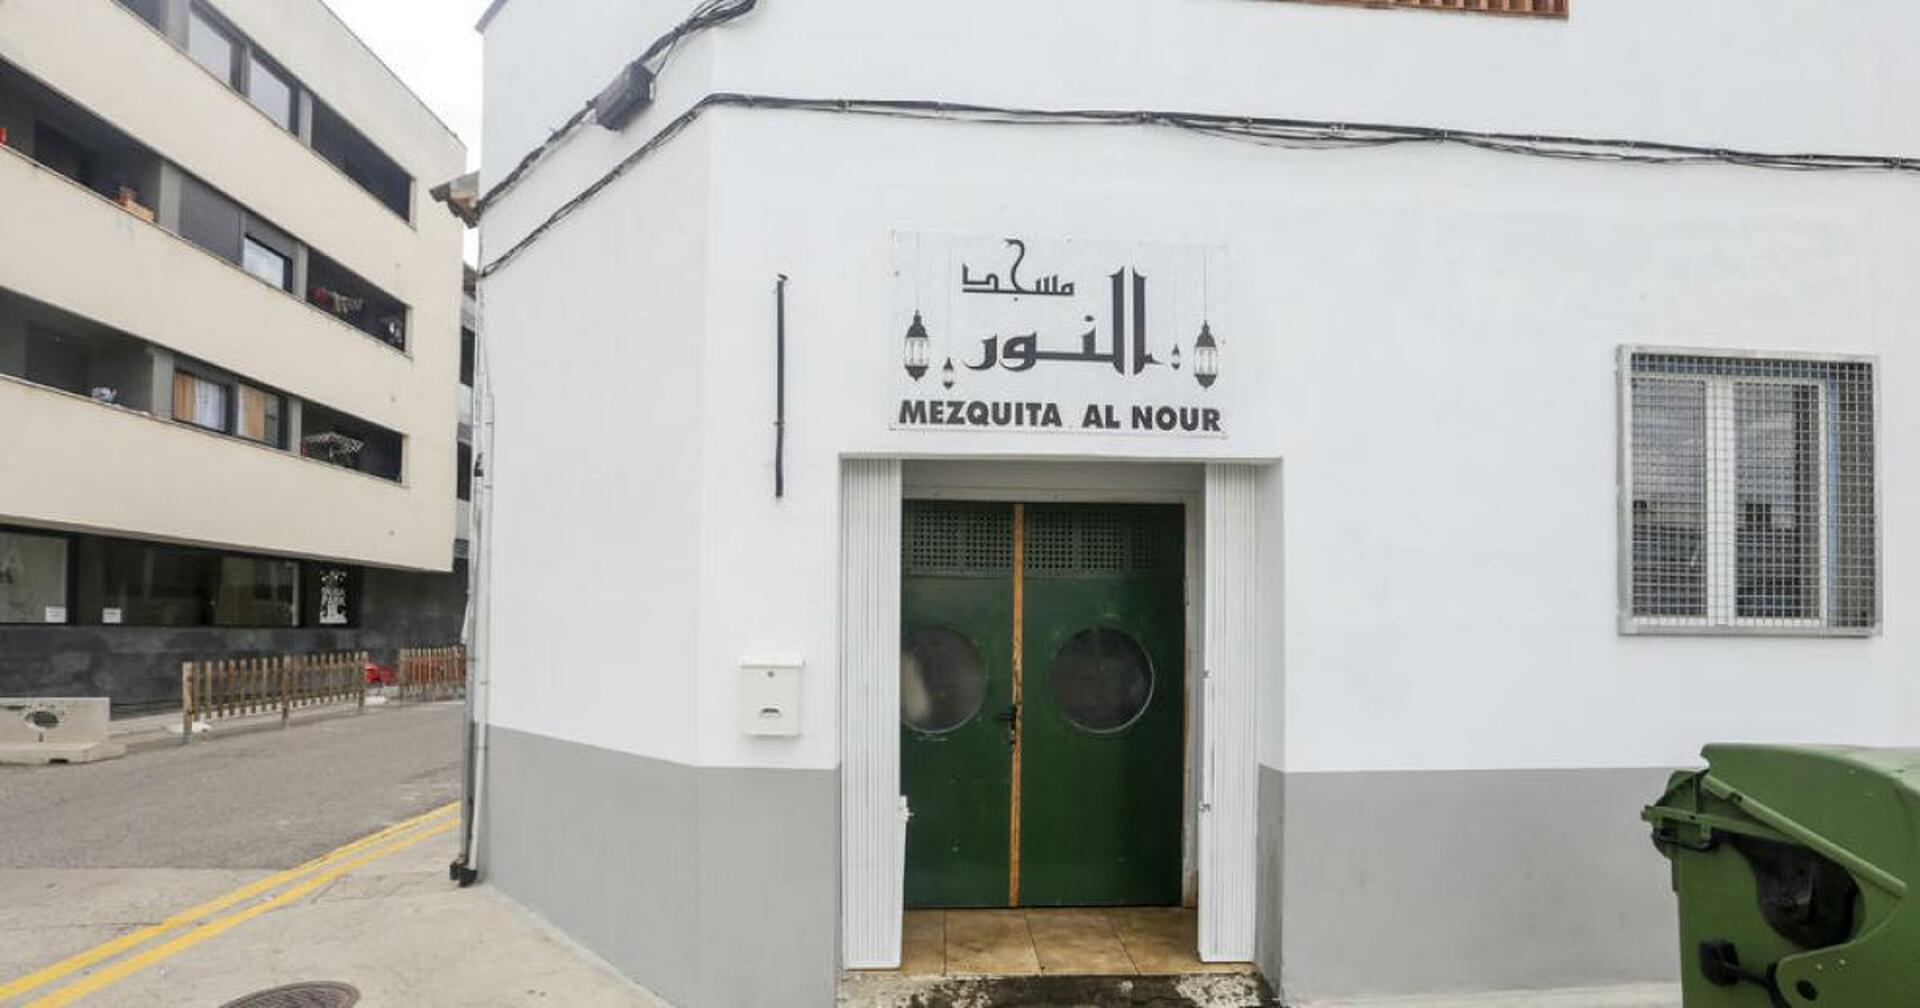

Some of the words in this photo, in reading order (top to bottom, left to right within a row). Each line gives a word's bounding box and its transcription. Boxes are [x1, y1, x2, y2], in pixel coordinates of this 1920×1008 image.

[962, 239, 1075, 301] مسجد
[963, 266, 1166, 376] النور
[898, 400, 1062, 427] MEZQUITA
[1082, 404, 1119, 429] AL
[1132, 406, 1221, 431] NOUR
